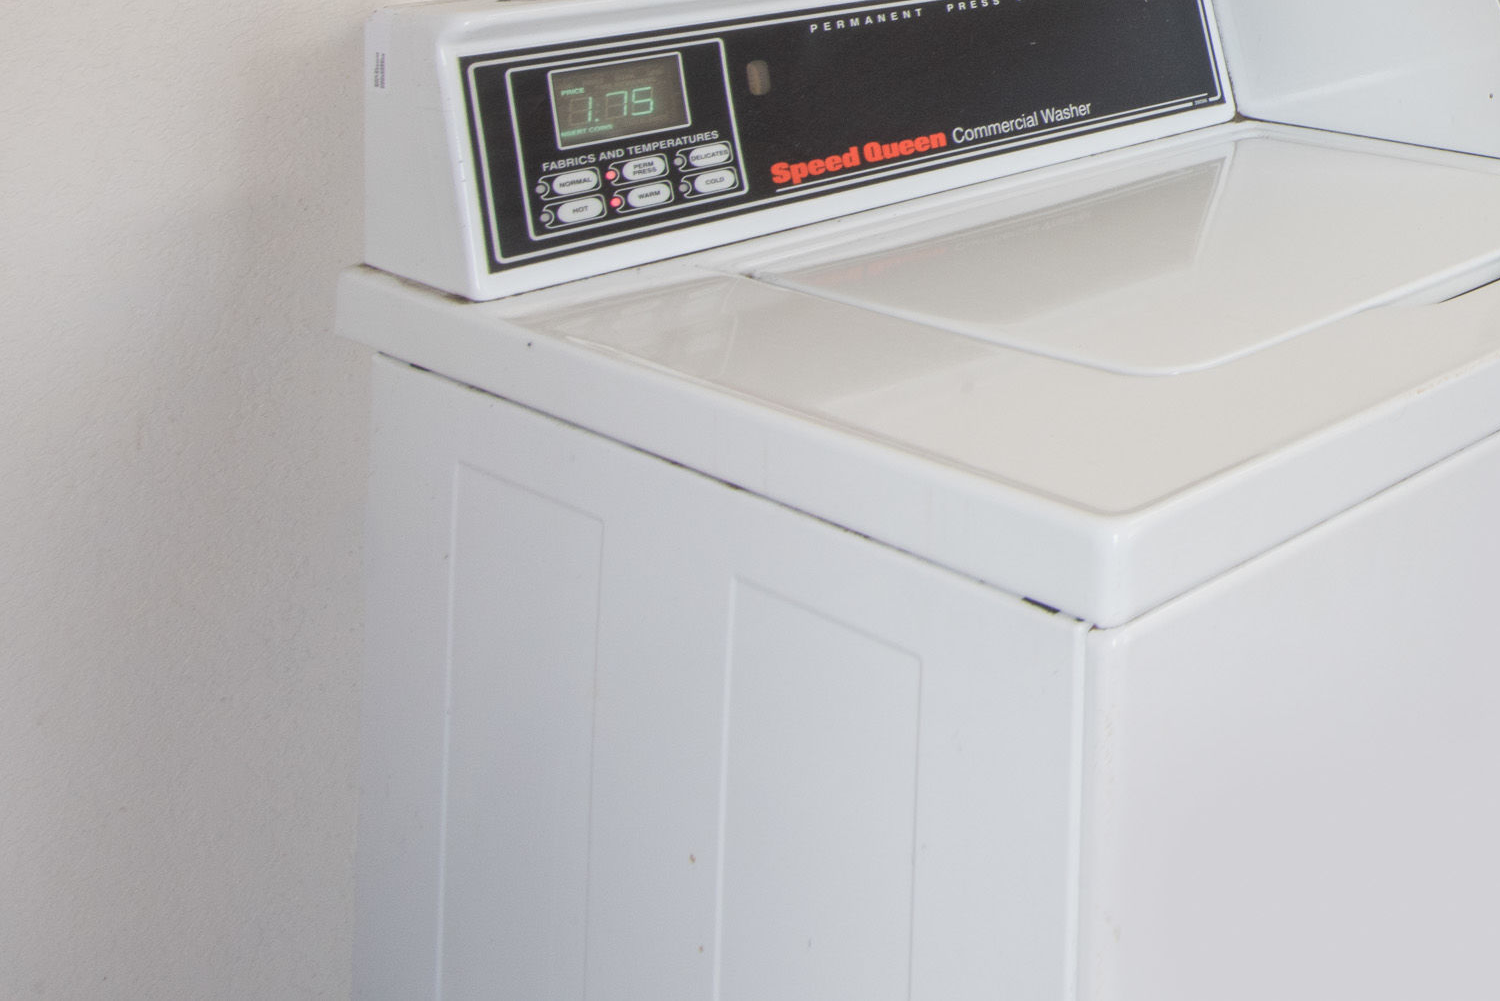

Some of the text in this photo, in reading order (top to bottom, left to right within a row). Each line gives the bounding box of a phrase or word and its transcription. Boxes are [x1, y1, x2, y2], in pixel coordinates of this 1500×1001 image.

[809, 7, 924, 34] PERMANENT
[561, 86, 585, 96] PRICE
[586, 85, 654, 123] 1.75
[770, 101, 1092, 185] Speed Queen Commercial Washer
[542, 130, 720, 173] FABRICS AND TEMPERATURES
[691, 148, 730, 162] DELICATES
[632, 166, 658, 177] PRESS
[633, 160, 655, 171] PERM
[558, 176, 593, 189] NORMAL
[705, 175, 725, 186] COLD
[638, 189, 662, 201] WARM
[572, 205, 589, 215] HOT
